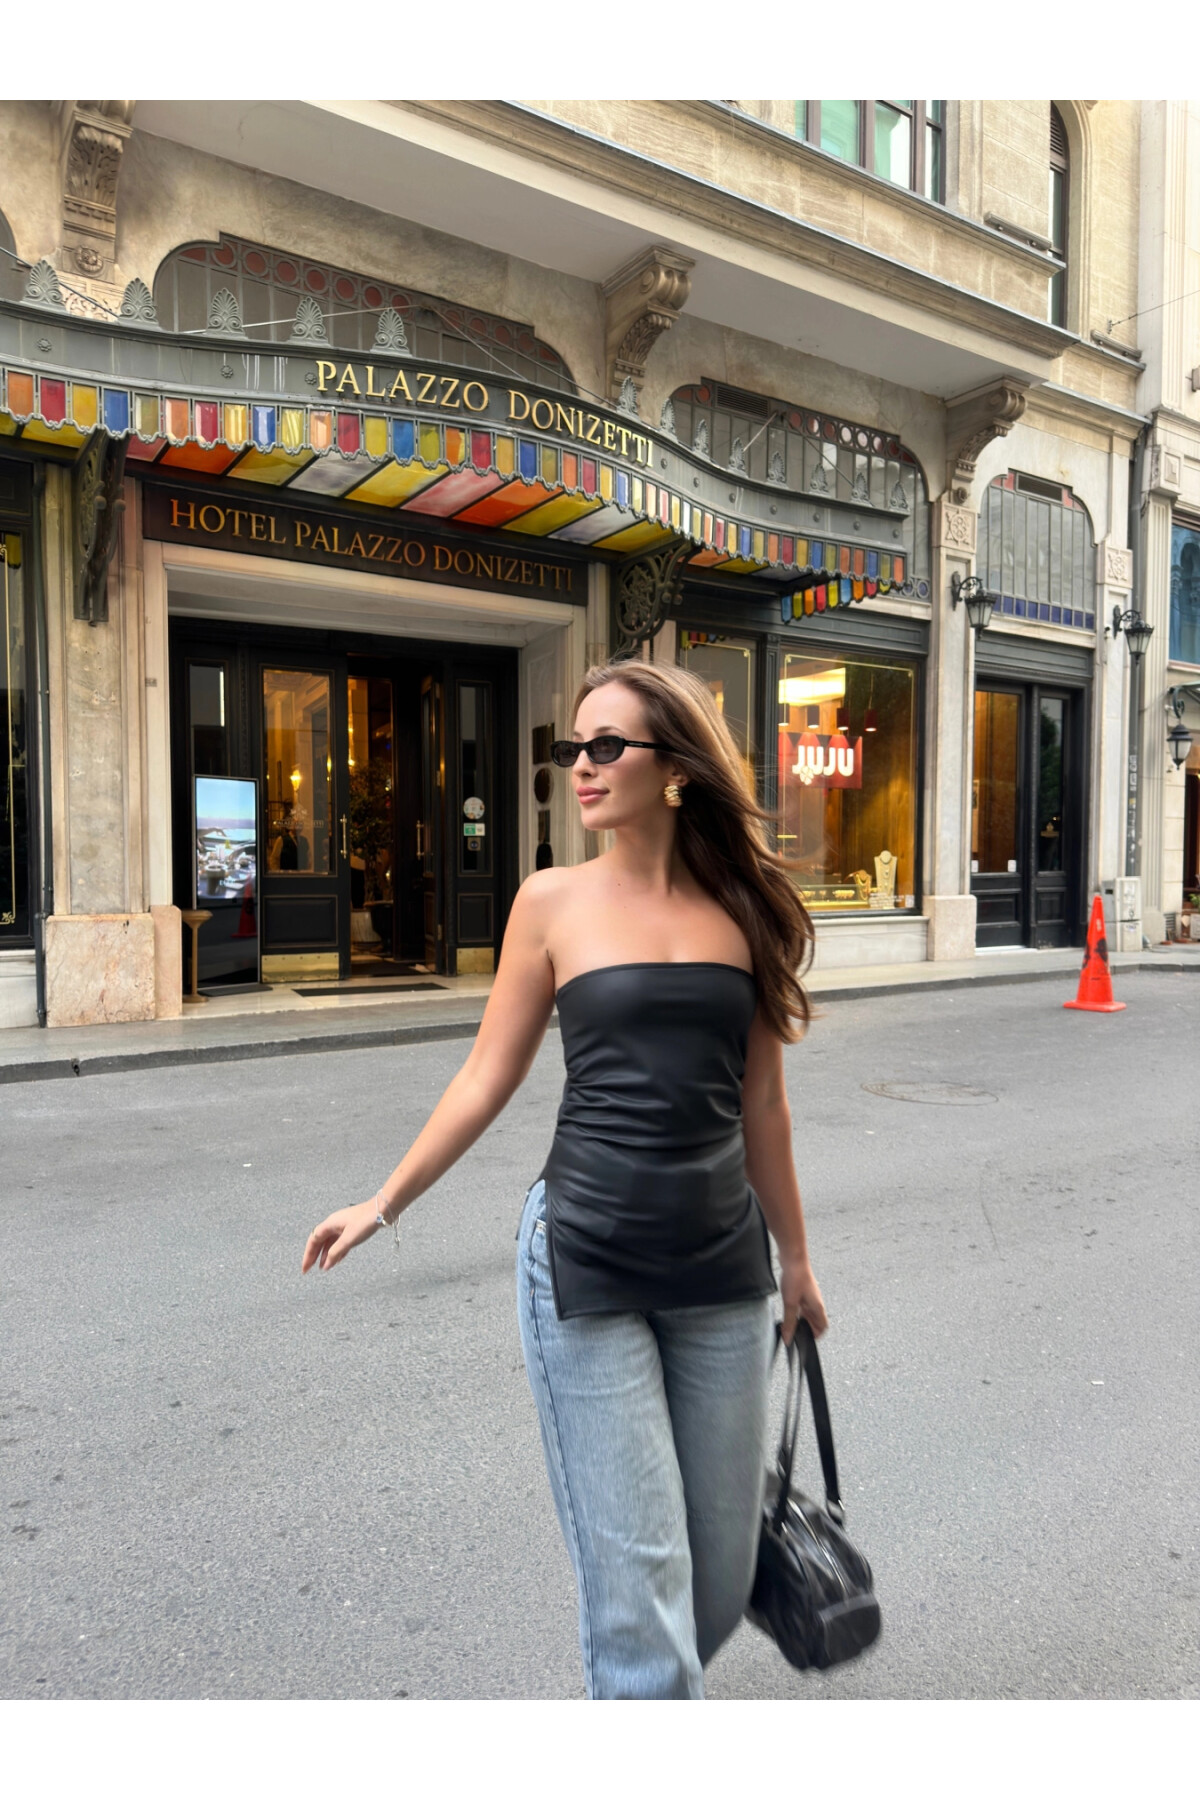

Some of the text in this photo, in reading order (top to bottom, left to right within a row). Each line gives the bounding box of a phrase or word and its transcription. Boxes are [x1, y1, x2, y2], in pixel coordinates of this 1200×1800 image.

[316, 360, 654, 468] PALAZZO DONIZETTI
[170, 499, 574, 592] HOTEL PALAZZO DONIZETTI
[791, 745, 854, 777] JUJU
